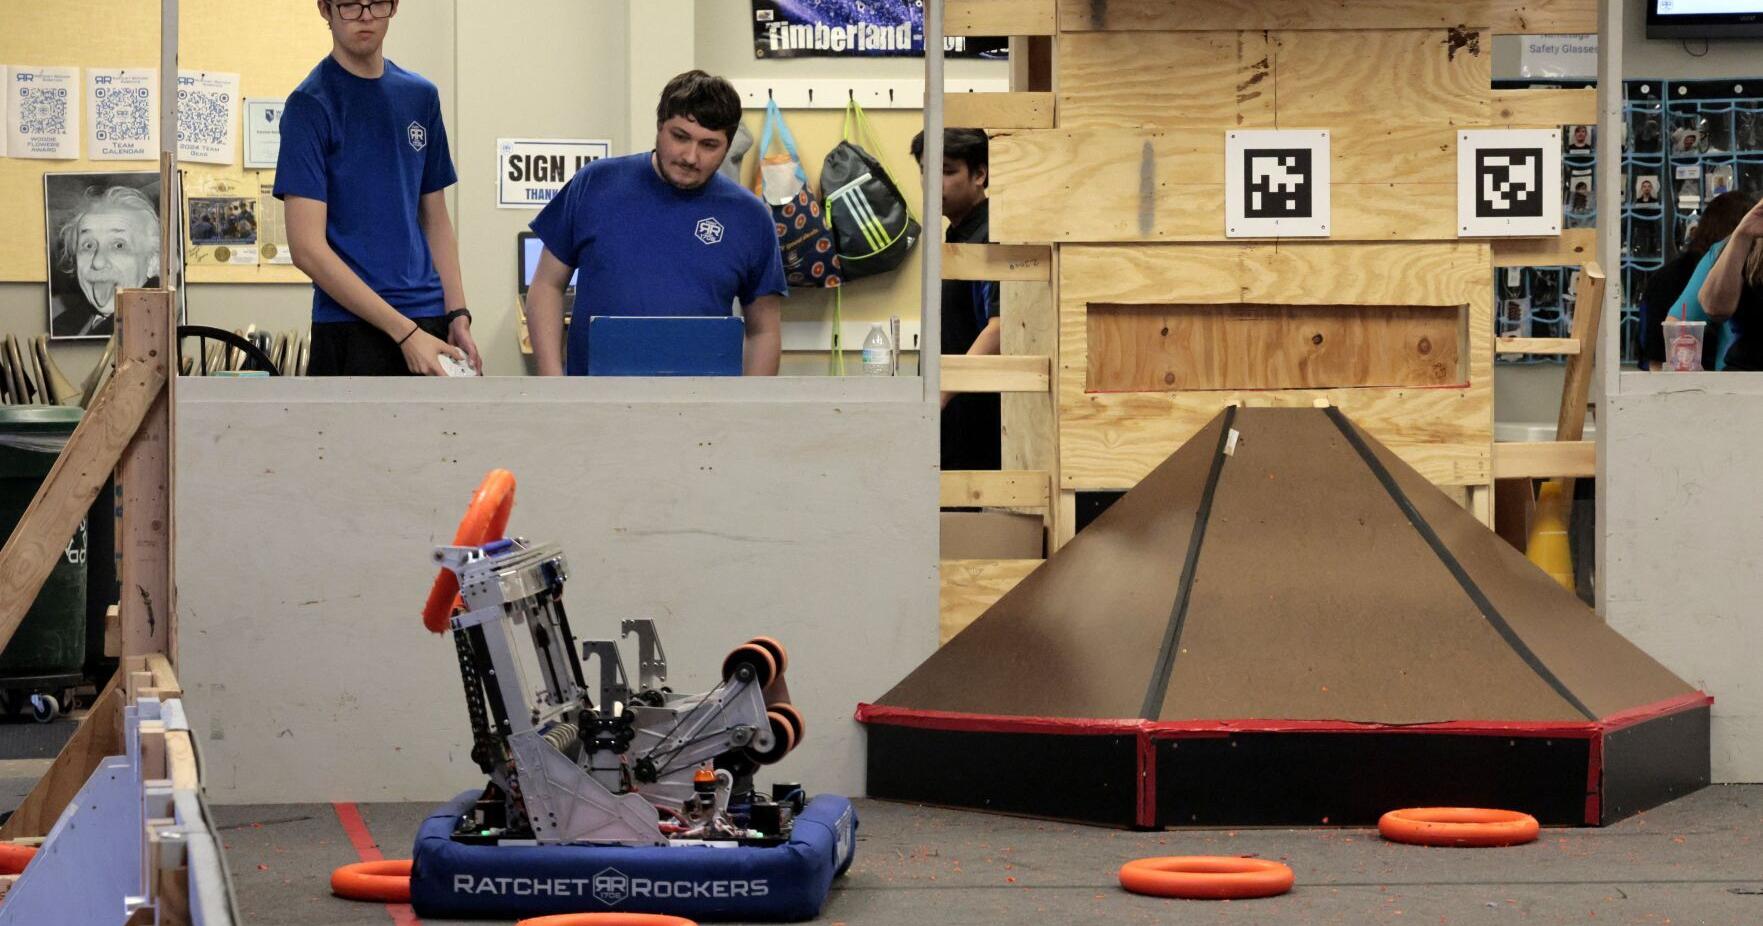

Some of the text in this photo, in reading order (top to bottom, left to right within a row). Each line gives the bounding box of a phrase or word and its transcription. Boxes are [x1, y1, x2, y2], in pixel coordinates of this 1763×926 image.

[1529, 44, 1559, 55] Safety
[508, 154, 565, 183] SIGN
[453, 873, 769, 898] RATCHET ROCKERS
